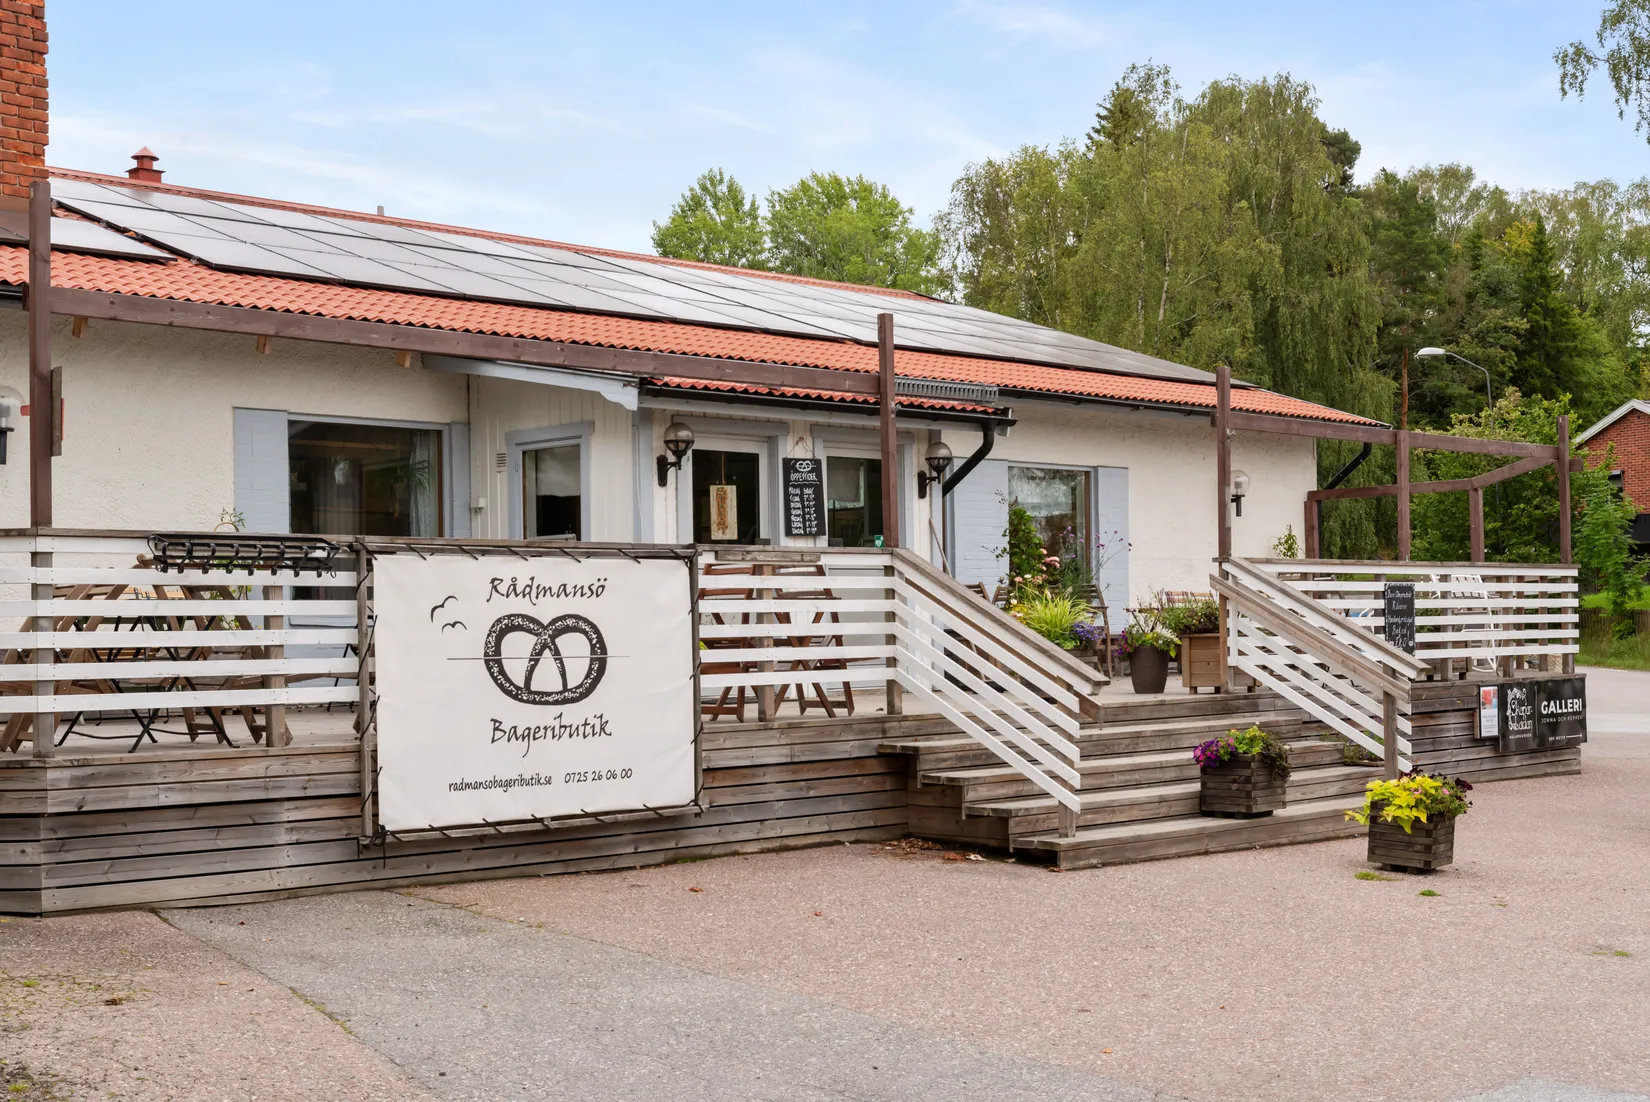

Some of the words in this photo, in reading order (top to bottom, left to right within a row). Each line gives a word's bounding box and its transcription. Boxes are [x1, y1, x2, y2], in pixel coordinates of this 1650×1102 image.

[486, 576, 608, 606] Rådmansö
[1541, 698, 1582, 714] GALLERI
[490, 712, 612, 758] Bageributik
[448, 772, 552, 794] radmansobageributik.se
[564, 771, 588, 784] 0725
[591, 770, 604, 782] 26
[605, 769, 618, 781] 06
[620, 768, 633, 780] 00
